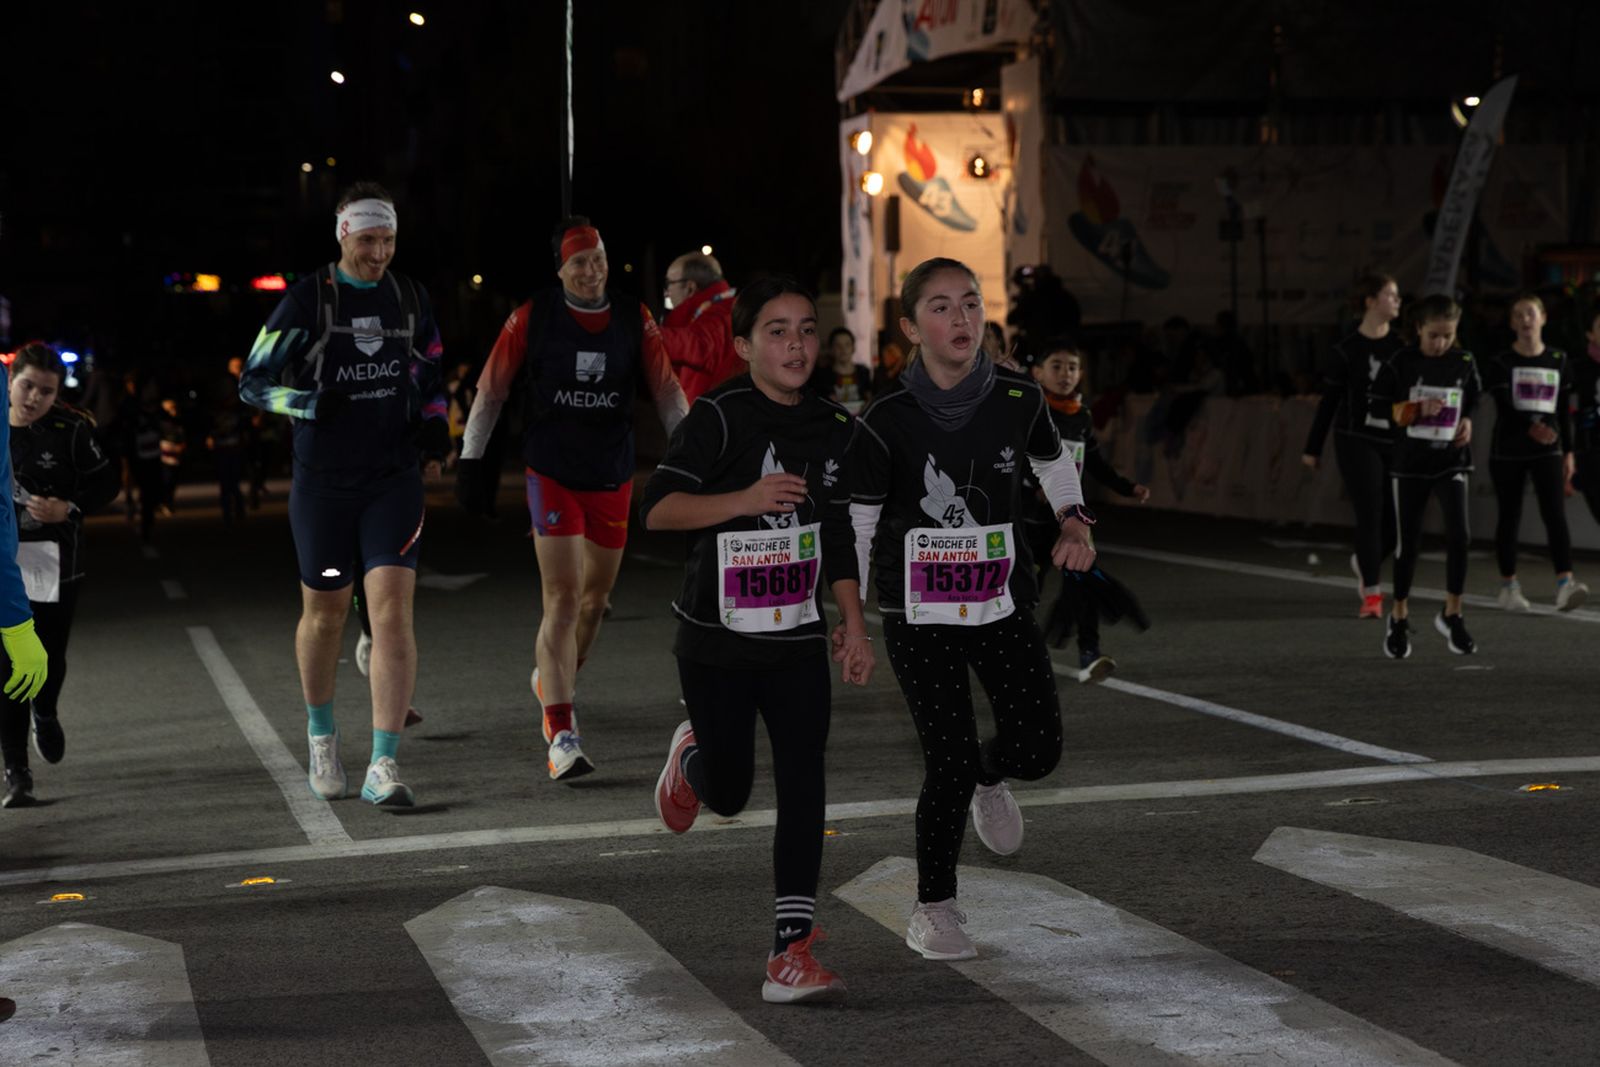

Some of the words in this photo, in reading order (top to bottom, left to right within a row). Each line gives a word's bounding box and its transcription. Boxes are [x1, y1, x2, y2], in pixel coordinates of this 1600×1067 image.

[336, 359, 400, 382] MEDAC
[553, 389, 620, 409] MEDAC
[942, 504, 965, 528] 43
[744, 541, 778, 552] NOCHE
[779, 539, 791, 550] DE
[931, 540, 963, 549] NOCHE
[965, 539, 978, 549] DE
[732, 555, 754, 566] SAN
[757, 550, 791, 566] ANTÓN
[918, 551, 939, 561] SAN
[942, 548, 978, 561] ANTÓN
[736, 561, 811, 598] 15681
[921, 561, 1002, 592] 15372
